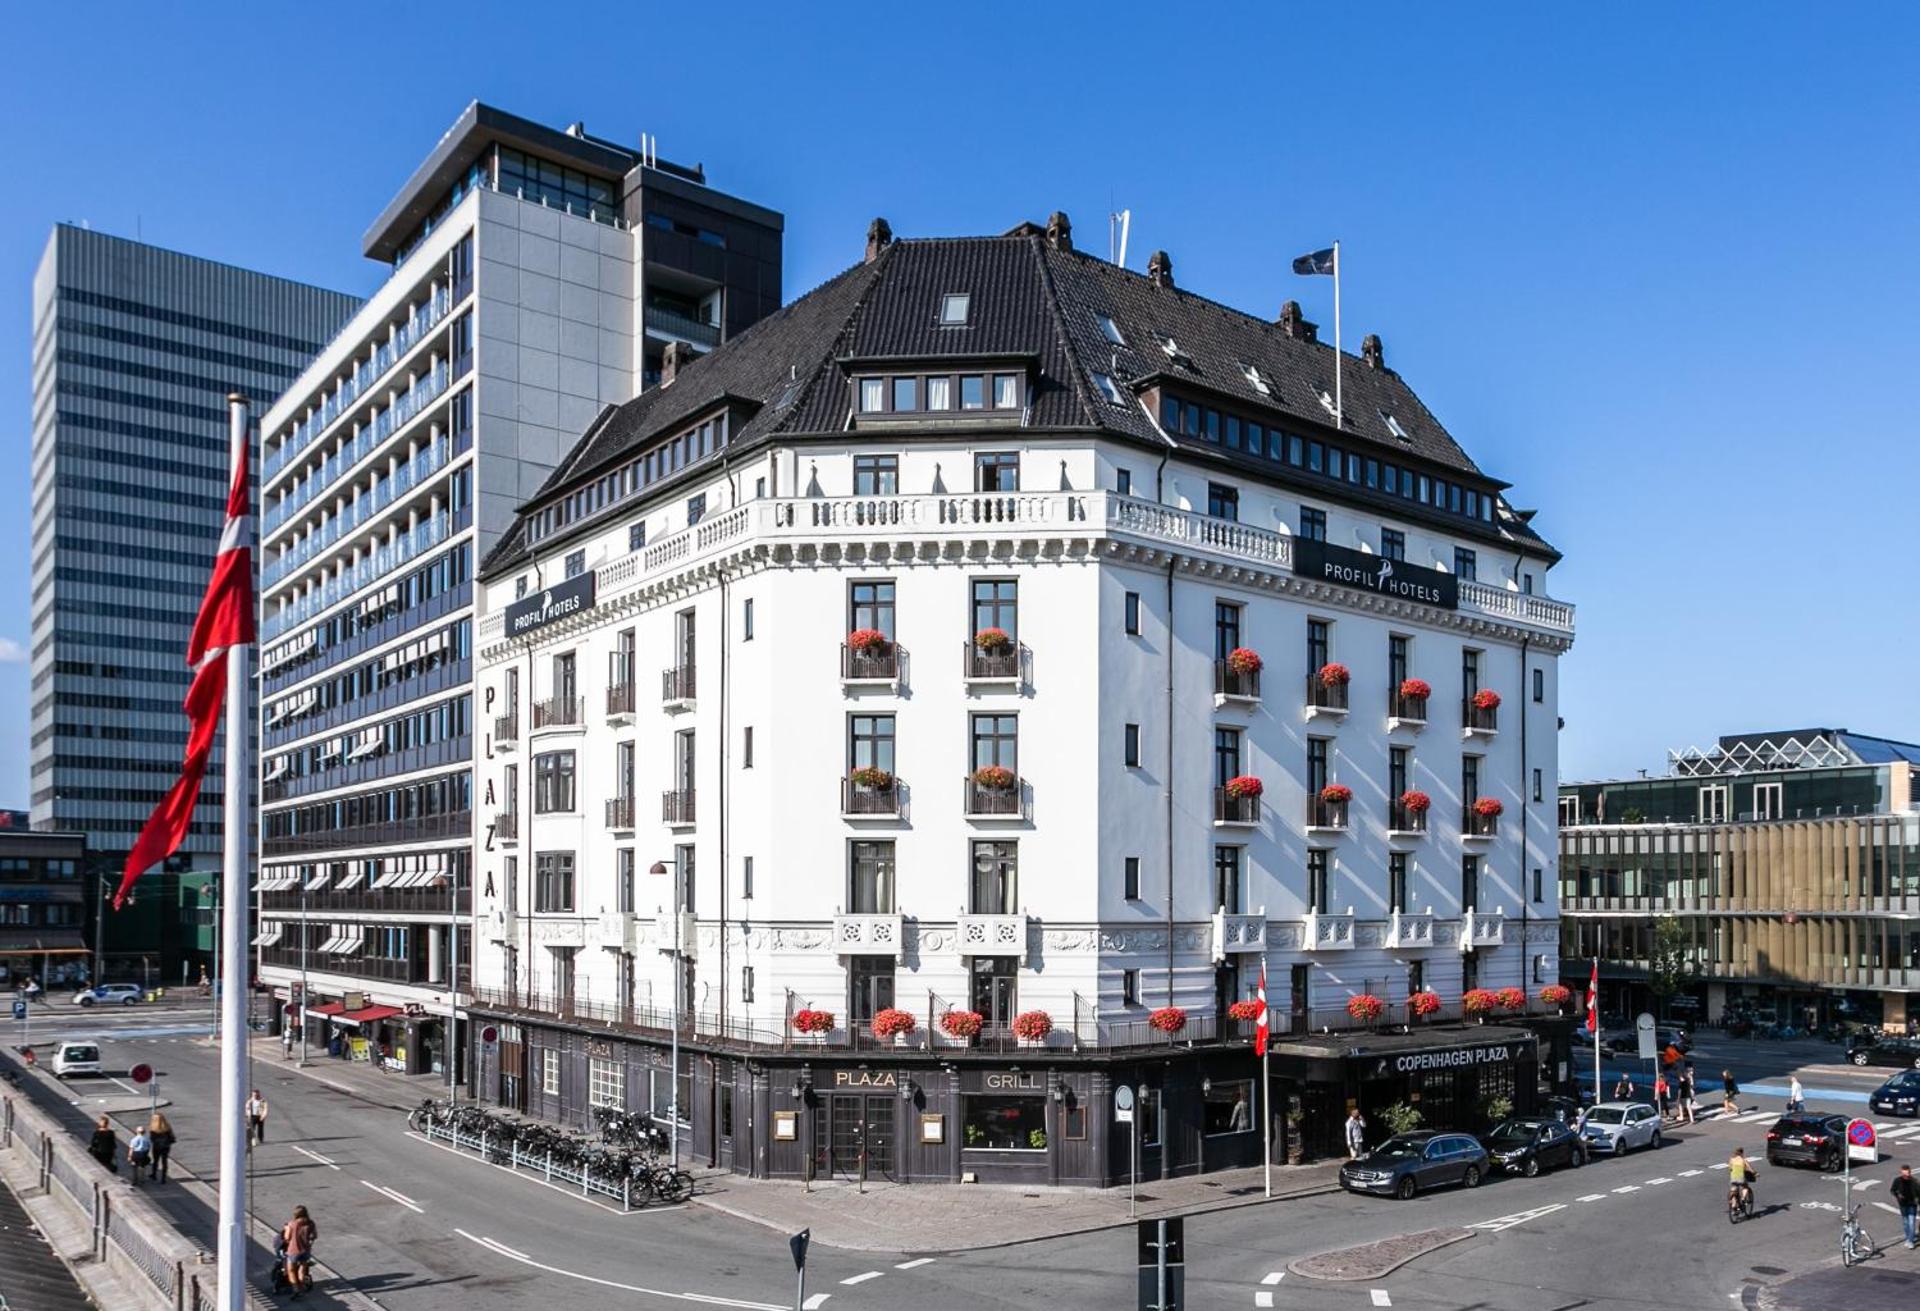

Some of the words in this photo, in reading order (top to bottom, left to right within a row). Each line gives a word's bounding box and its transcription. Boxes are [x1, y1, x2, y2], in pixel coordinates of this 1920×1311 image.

[1325, 563, 1374, 587] PROFIL
[1389, 579, 1440, 602] HOTELS
[514, 610, 542, 630] PROFIL
[548, 595, 580, 619] HOTELS
[485, 686, 495, 897] PLAZA
[15, 1003, 24, 1012] P
[1397, 1053, 1474, 1071] COPENHAGEN
[1476, 1046, 1509, 1063] PLAZA
[836, 1072, 896, 1086] PLAZA
[987, 1074, 1042, 1089] GRILL
